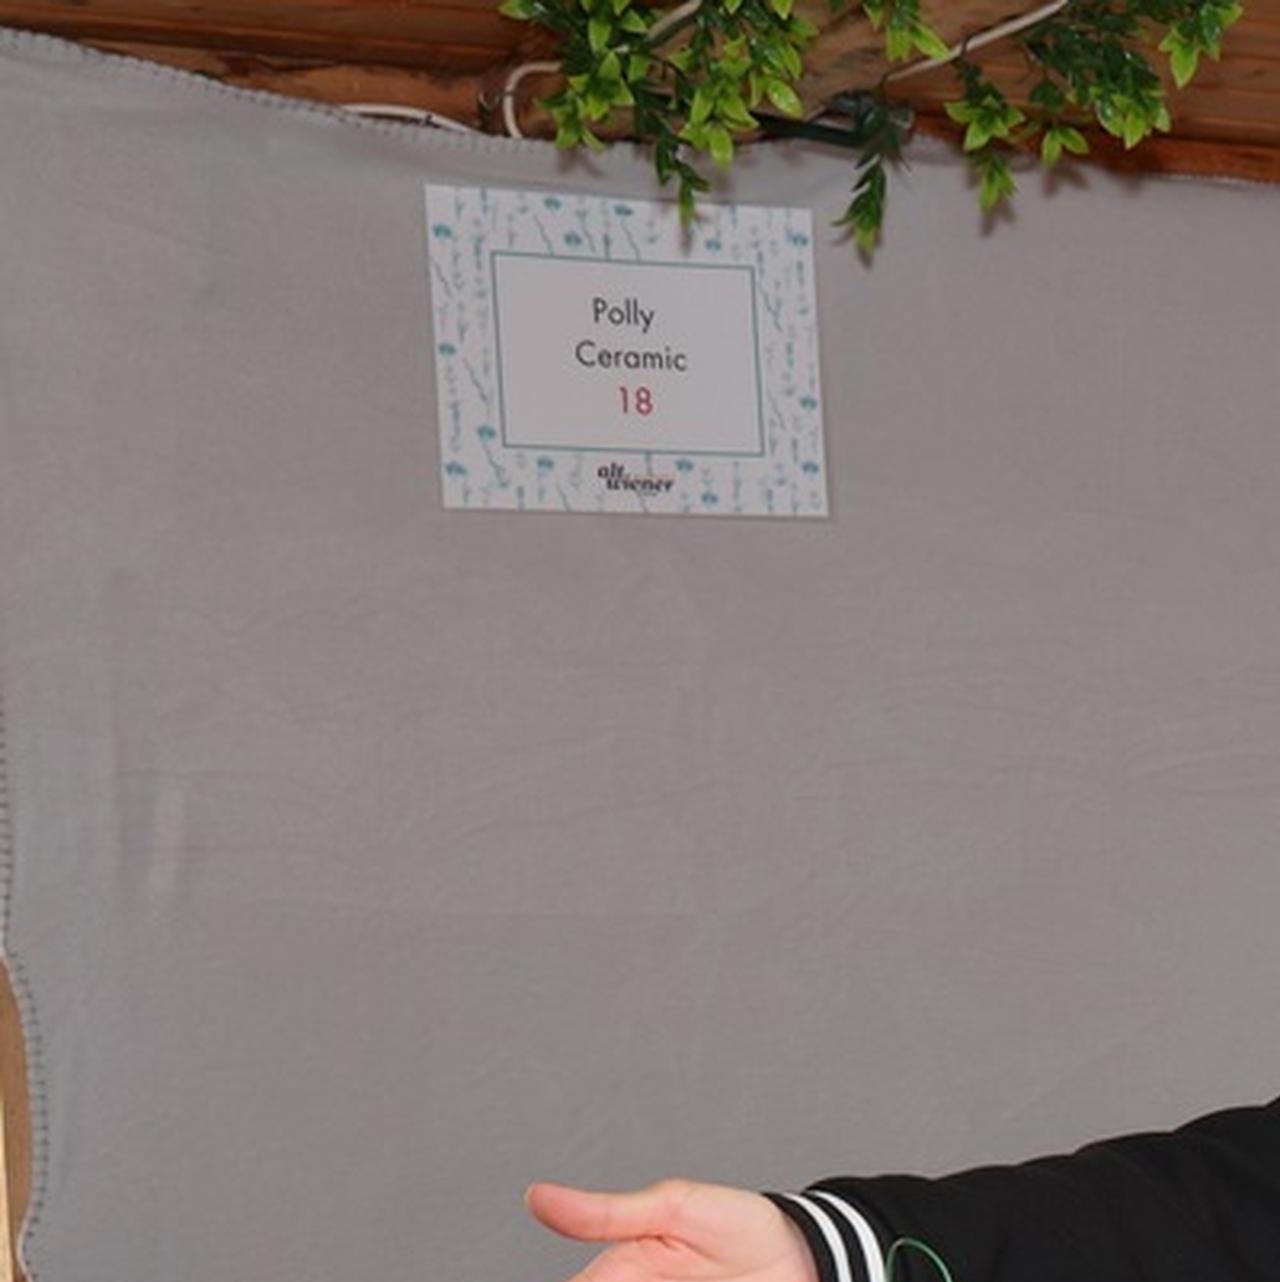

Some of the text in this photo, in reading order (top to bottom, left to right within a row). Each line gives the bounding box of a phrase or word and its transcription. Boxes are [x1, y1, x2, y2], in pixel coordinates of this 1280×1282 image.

[592, 297, 656, 331] Polly
[574, 340, 688, 374] Ceramic
[617, 387, 654, 416] 18
[597, 461, 625, 479] alt
